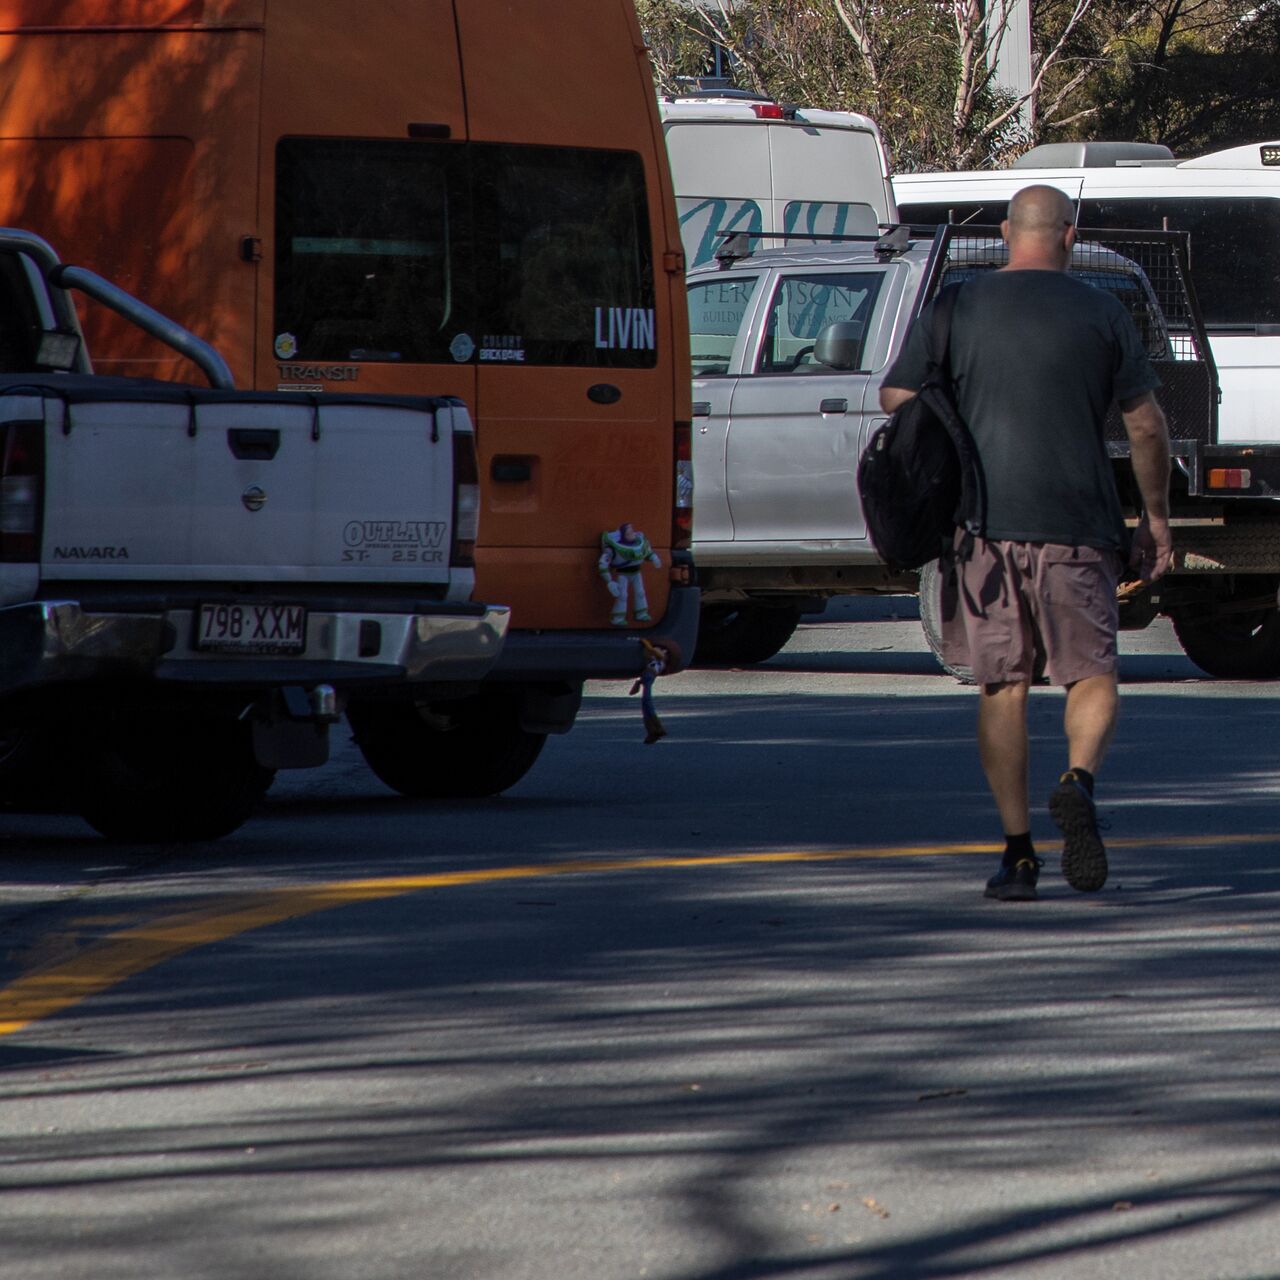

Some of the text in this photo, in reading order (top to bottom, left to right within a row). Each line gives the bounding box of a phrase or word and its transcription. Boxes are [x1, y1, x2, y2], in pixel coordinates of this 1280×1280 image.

[594, 306, 655, 350] LIVIN
[278, 364, 360, 381] TRANSIT
[343, 520, 446, 548] OUTLAW
[53, 546, 130, 560] NAVARA
[392, 550, 417, 562] 2.5
[421, 550, 443, 562] CR
